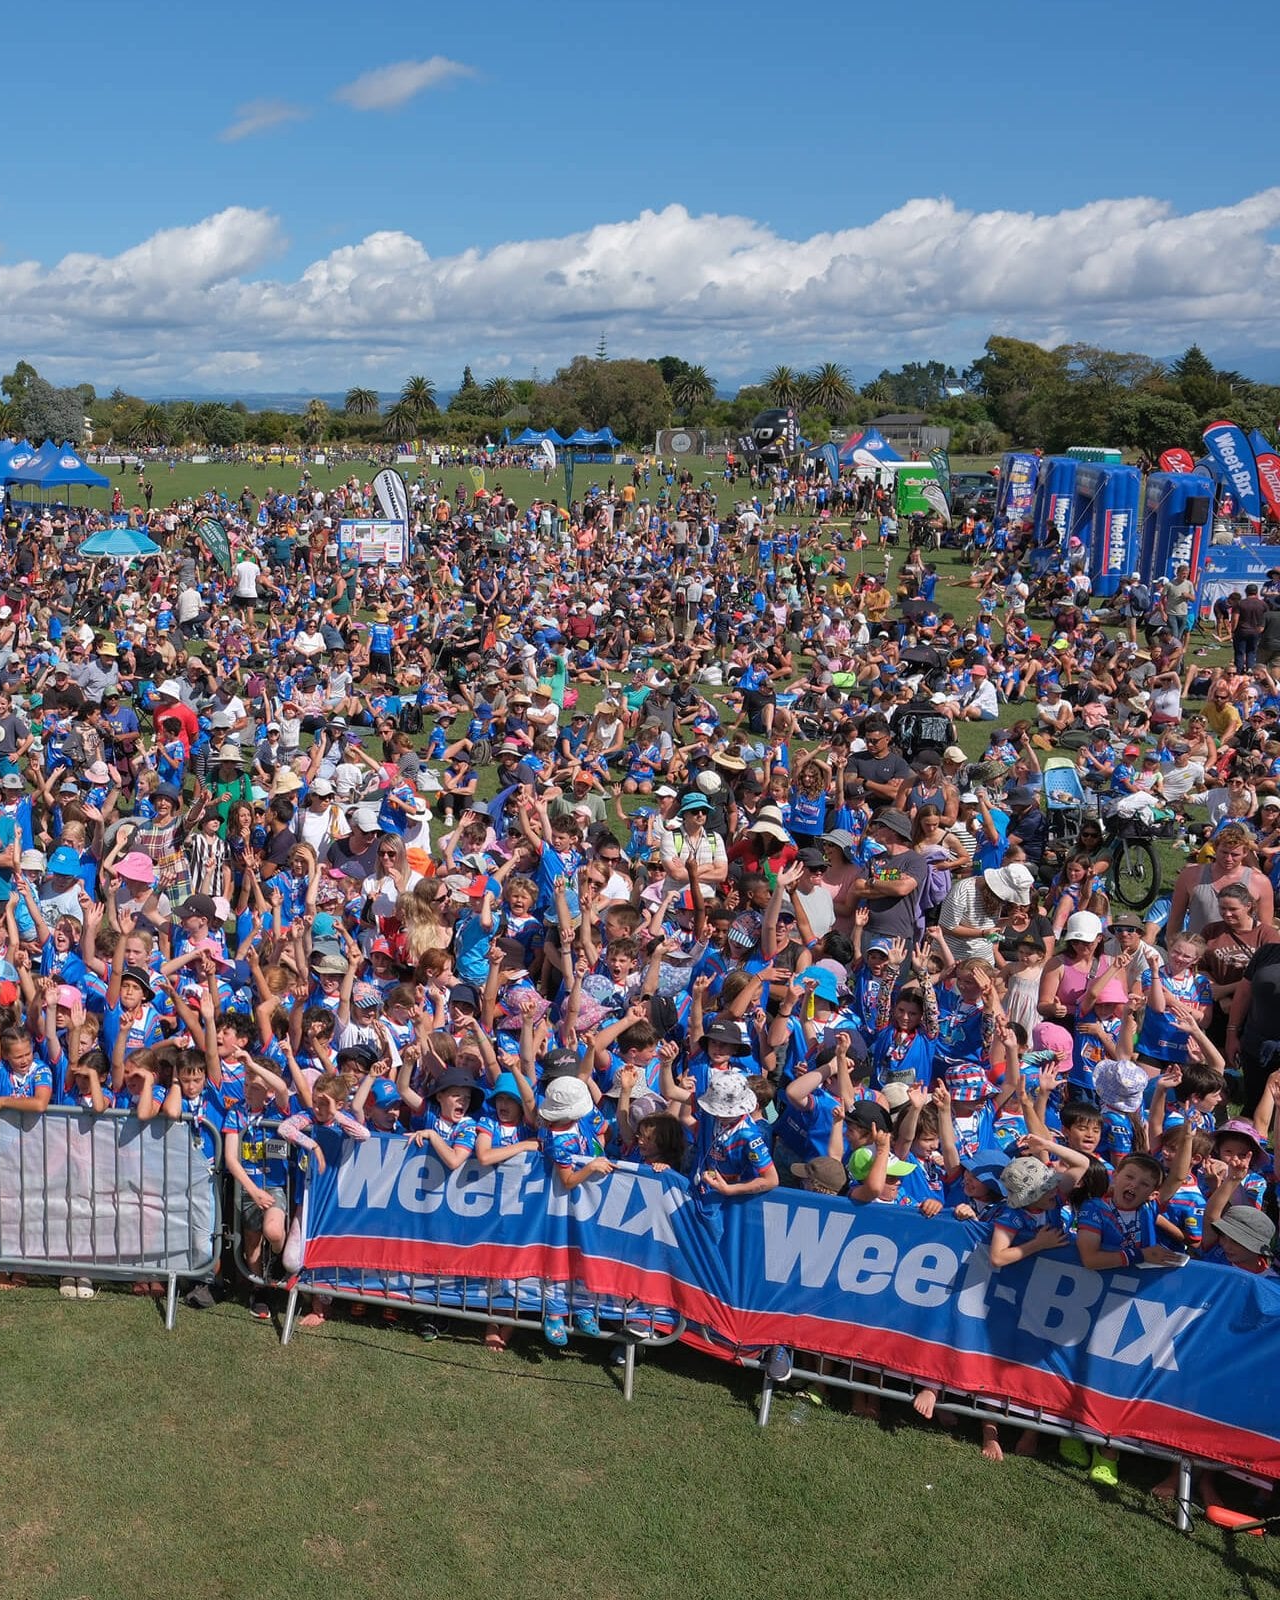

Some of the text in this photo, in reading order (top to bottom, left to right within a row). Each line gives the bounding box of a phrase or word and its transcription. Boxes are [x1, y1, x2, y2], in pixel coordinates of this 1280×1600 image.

[1214, 432, 1255, 498] Weet-Bix
[1108, 513, 1129, 571] Weet-Bix
[762, 1201, 1206, 1372] Weet-Bix
